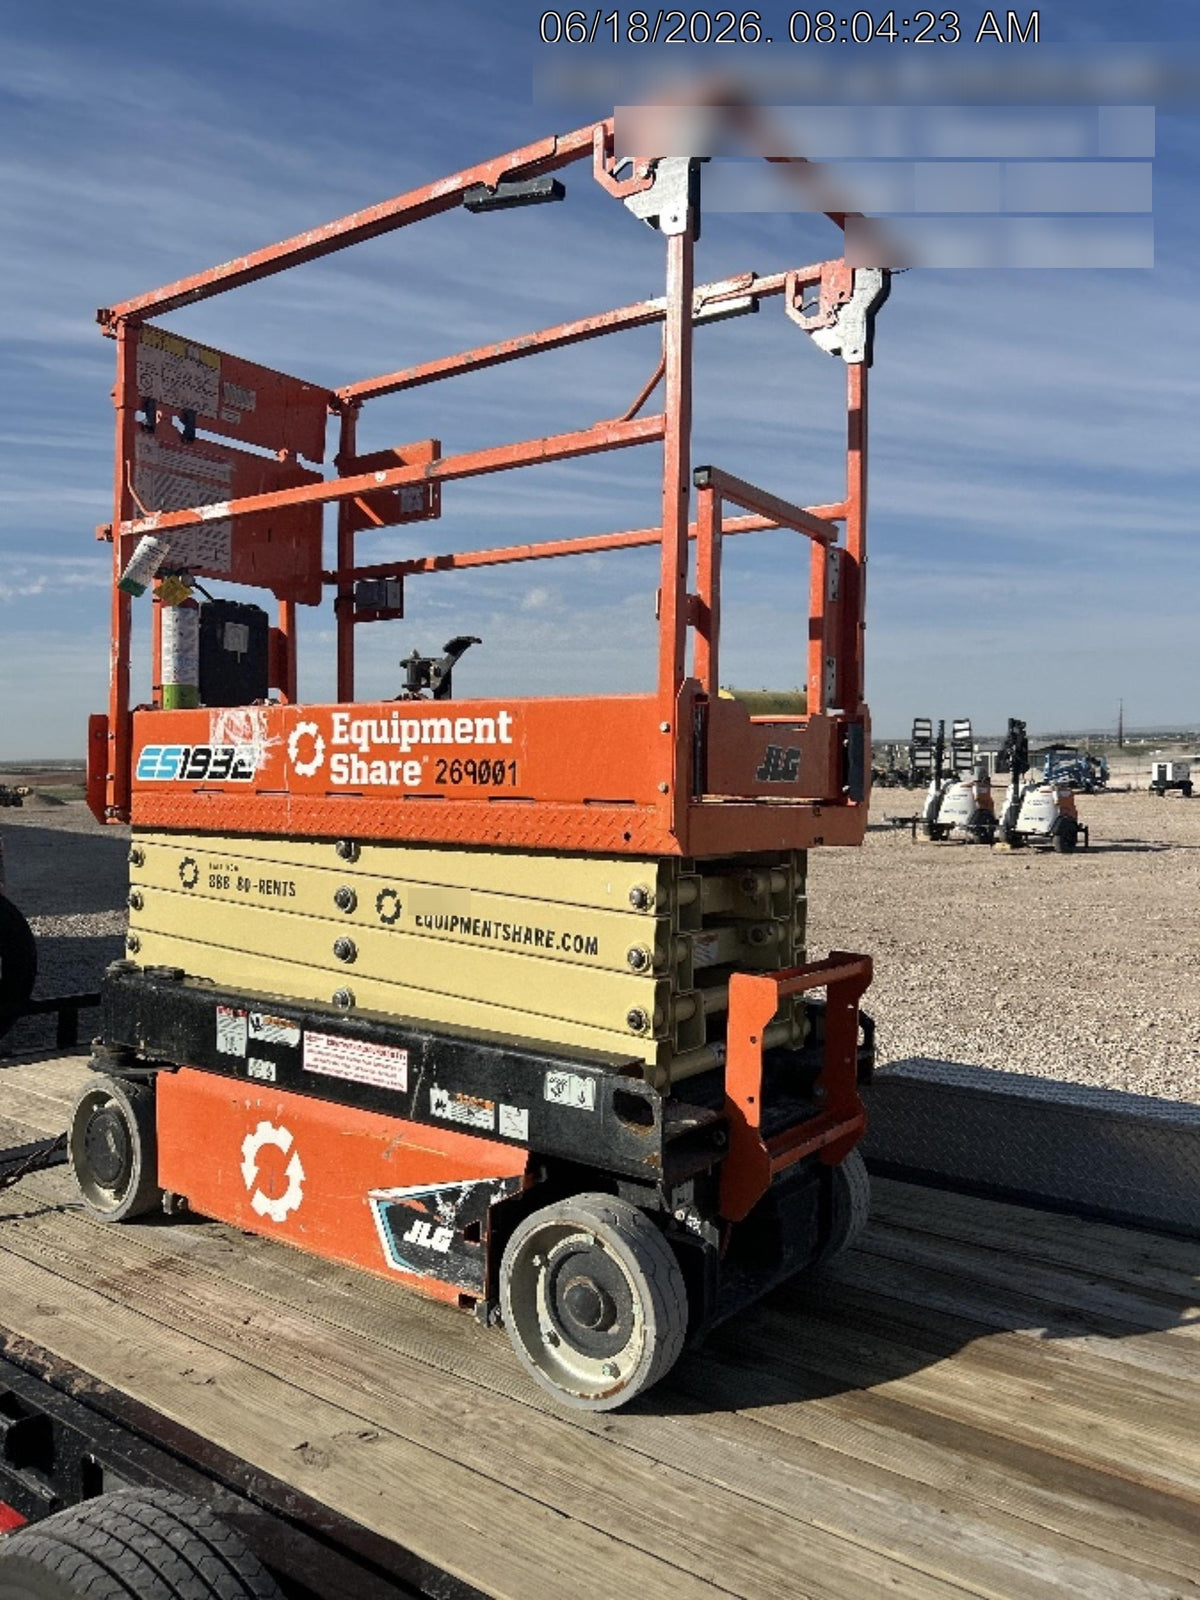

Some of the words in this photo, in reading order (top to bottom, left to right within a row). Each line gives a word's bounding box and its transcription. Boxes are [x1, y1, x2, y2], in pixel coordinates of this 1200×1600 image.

[331, 711, 513, 753] Equipment
[330, 753, 422, 786] Share
[434, 758, 517, 786] 269001
[754, 745, 802, 783] JLG
[415, 914, 598, 955] EQUIPMENTSHARE.COM
[403, 1219, 454, 1253] JLG
